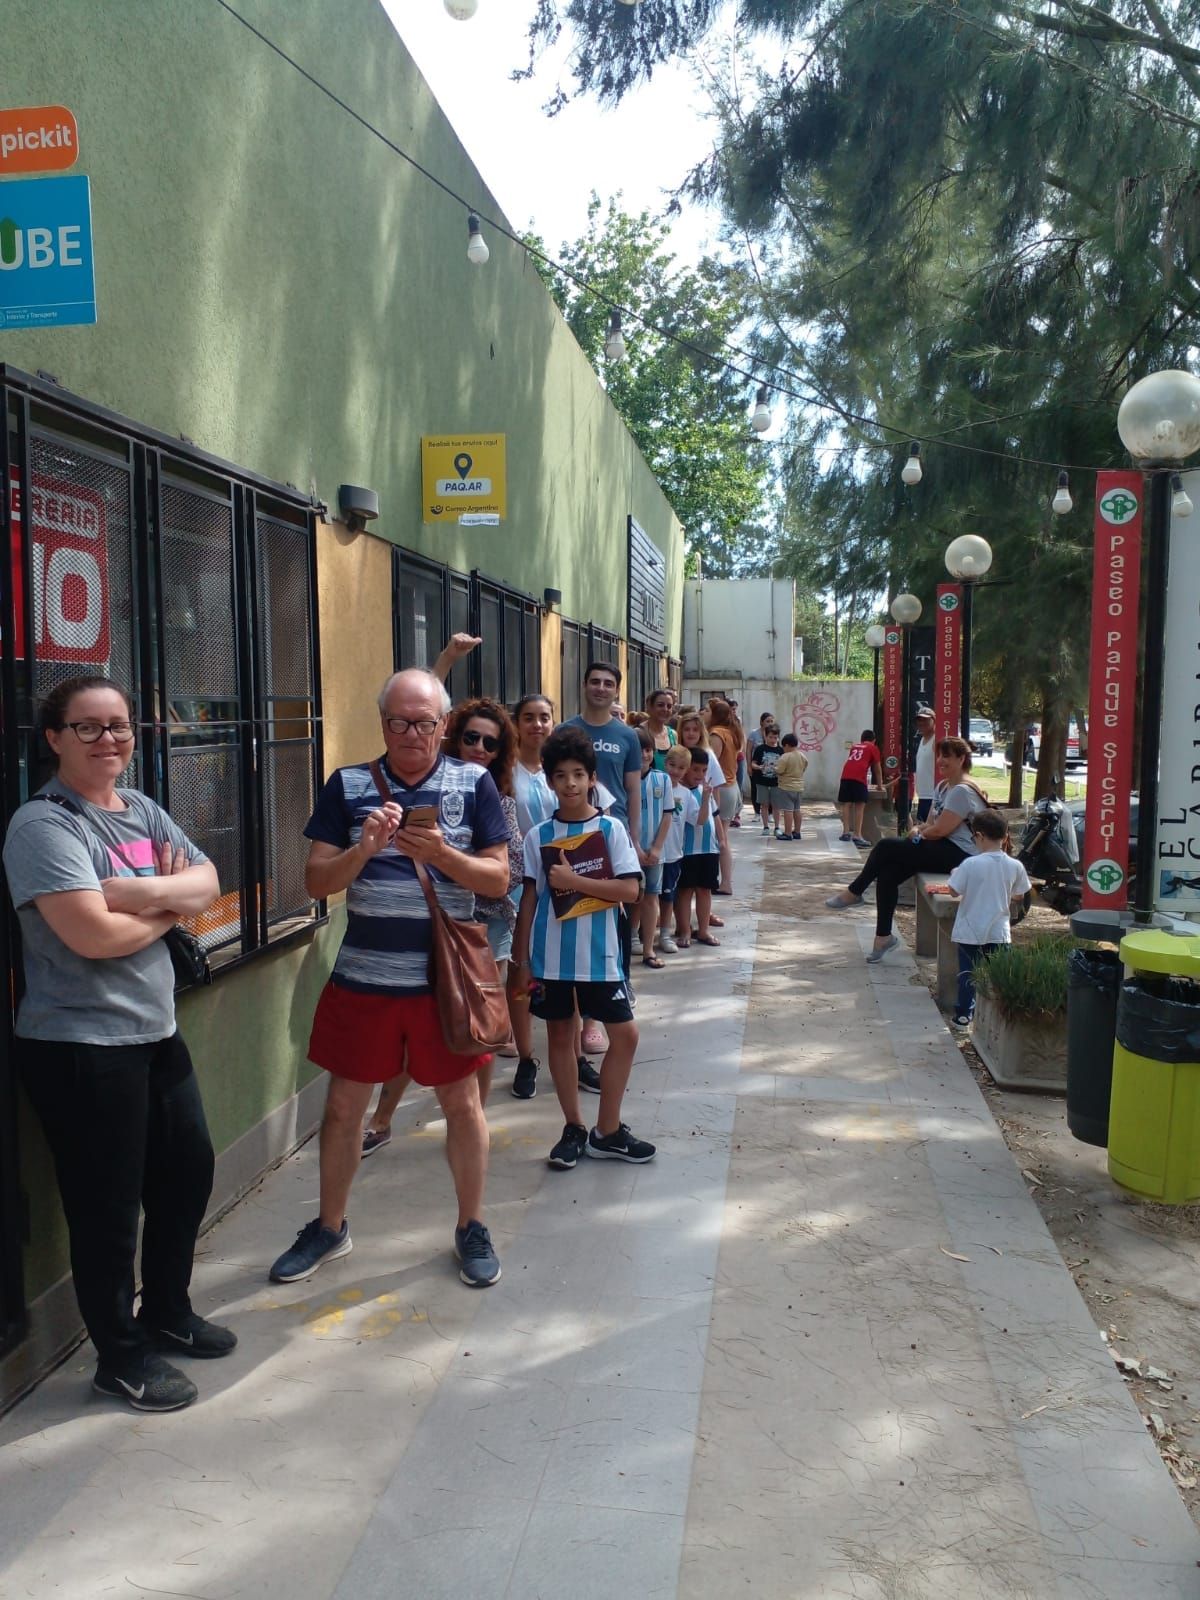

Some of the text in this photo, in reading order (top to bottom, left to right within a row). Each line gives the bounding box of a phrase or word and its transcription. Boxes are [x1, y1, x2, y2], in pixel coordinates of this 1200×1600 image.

[1, 124, 72, 158] pickit
[0, 225, 82, 270] UBE
[445, 482, 482, 491] PAQ.AR
[467, 504, 498, 513] Argentino
[945, 616, 953, 657] Paseo
[943, 665, 952, 713] Parque
[1100, 535, 1124, 852] Paseo Parque Sicardi
[593, 738, 620, 753] das
[1158, 807, 1187, 860] EL
[573, 857, 604, 869] WORLD CUP
[586, 863, 603, 872] 2022
